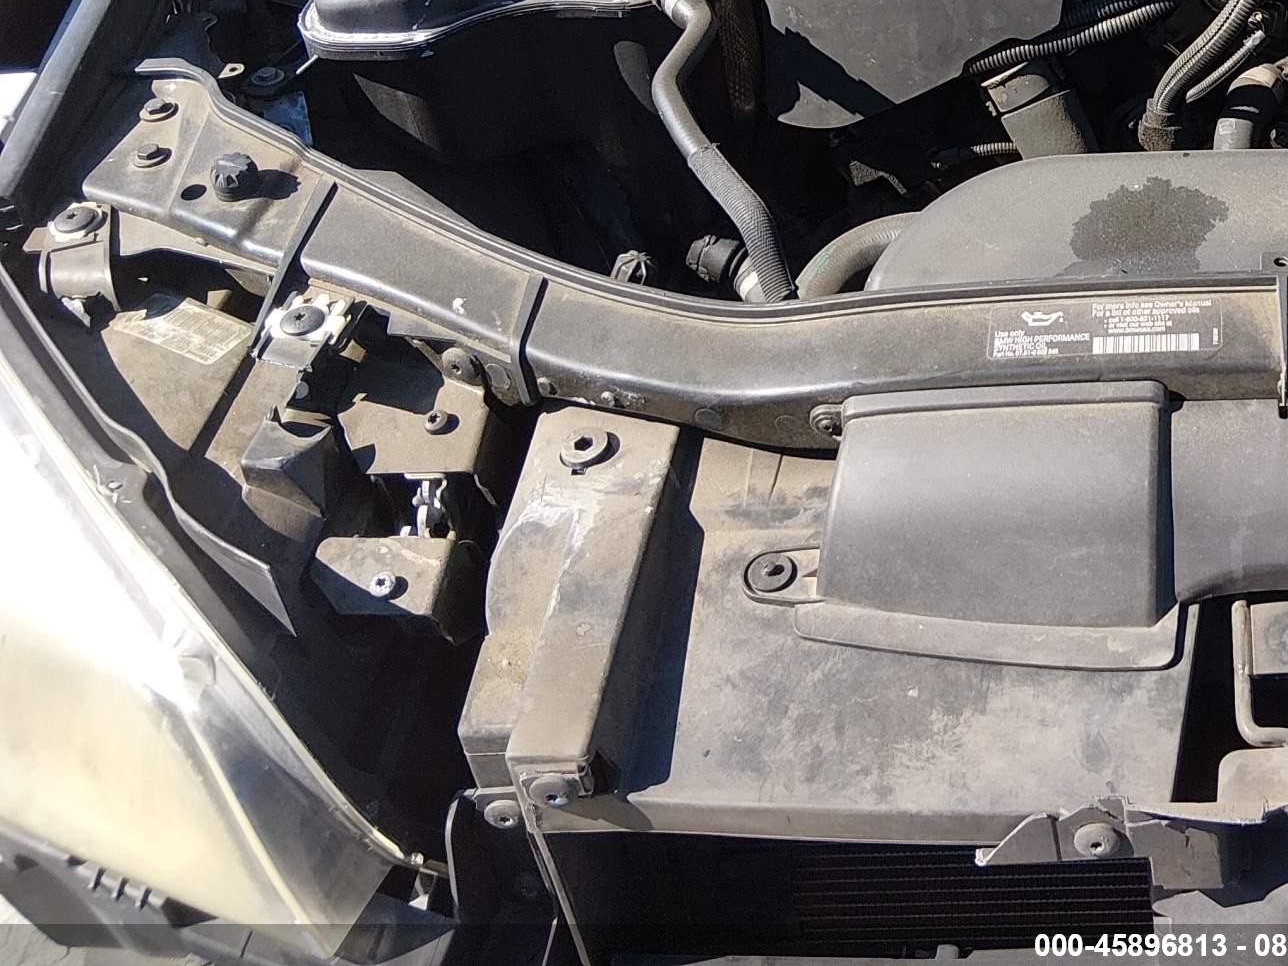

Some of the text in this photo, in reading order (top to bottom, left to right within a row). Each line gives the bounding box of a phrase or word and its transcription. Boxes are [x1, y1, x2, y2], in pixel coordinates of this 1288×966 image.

[1092, 303, 1103, 311] For
[1125, 301, 1139, 309] info
[1154, 300, 1183, 308] Owner's
[1185, 299, 1211, 307] Manual
[1092, 310, 1104, 318] For
[1152, 307, 1186, 315] approved
[994, 332, 1090, 344] BMW HIGH PERFORMANCE
[1010, 330, 1025, 338] only
[994, 342, 1034, 352] SYNTHETIC
[1036, 341, 1047, 350] OIL
